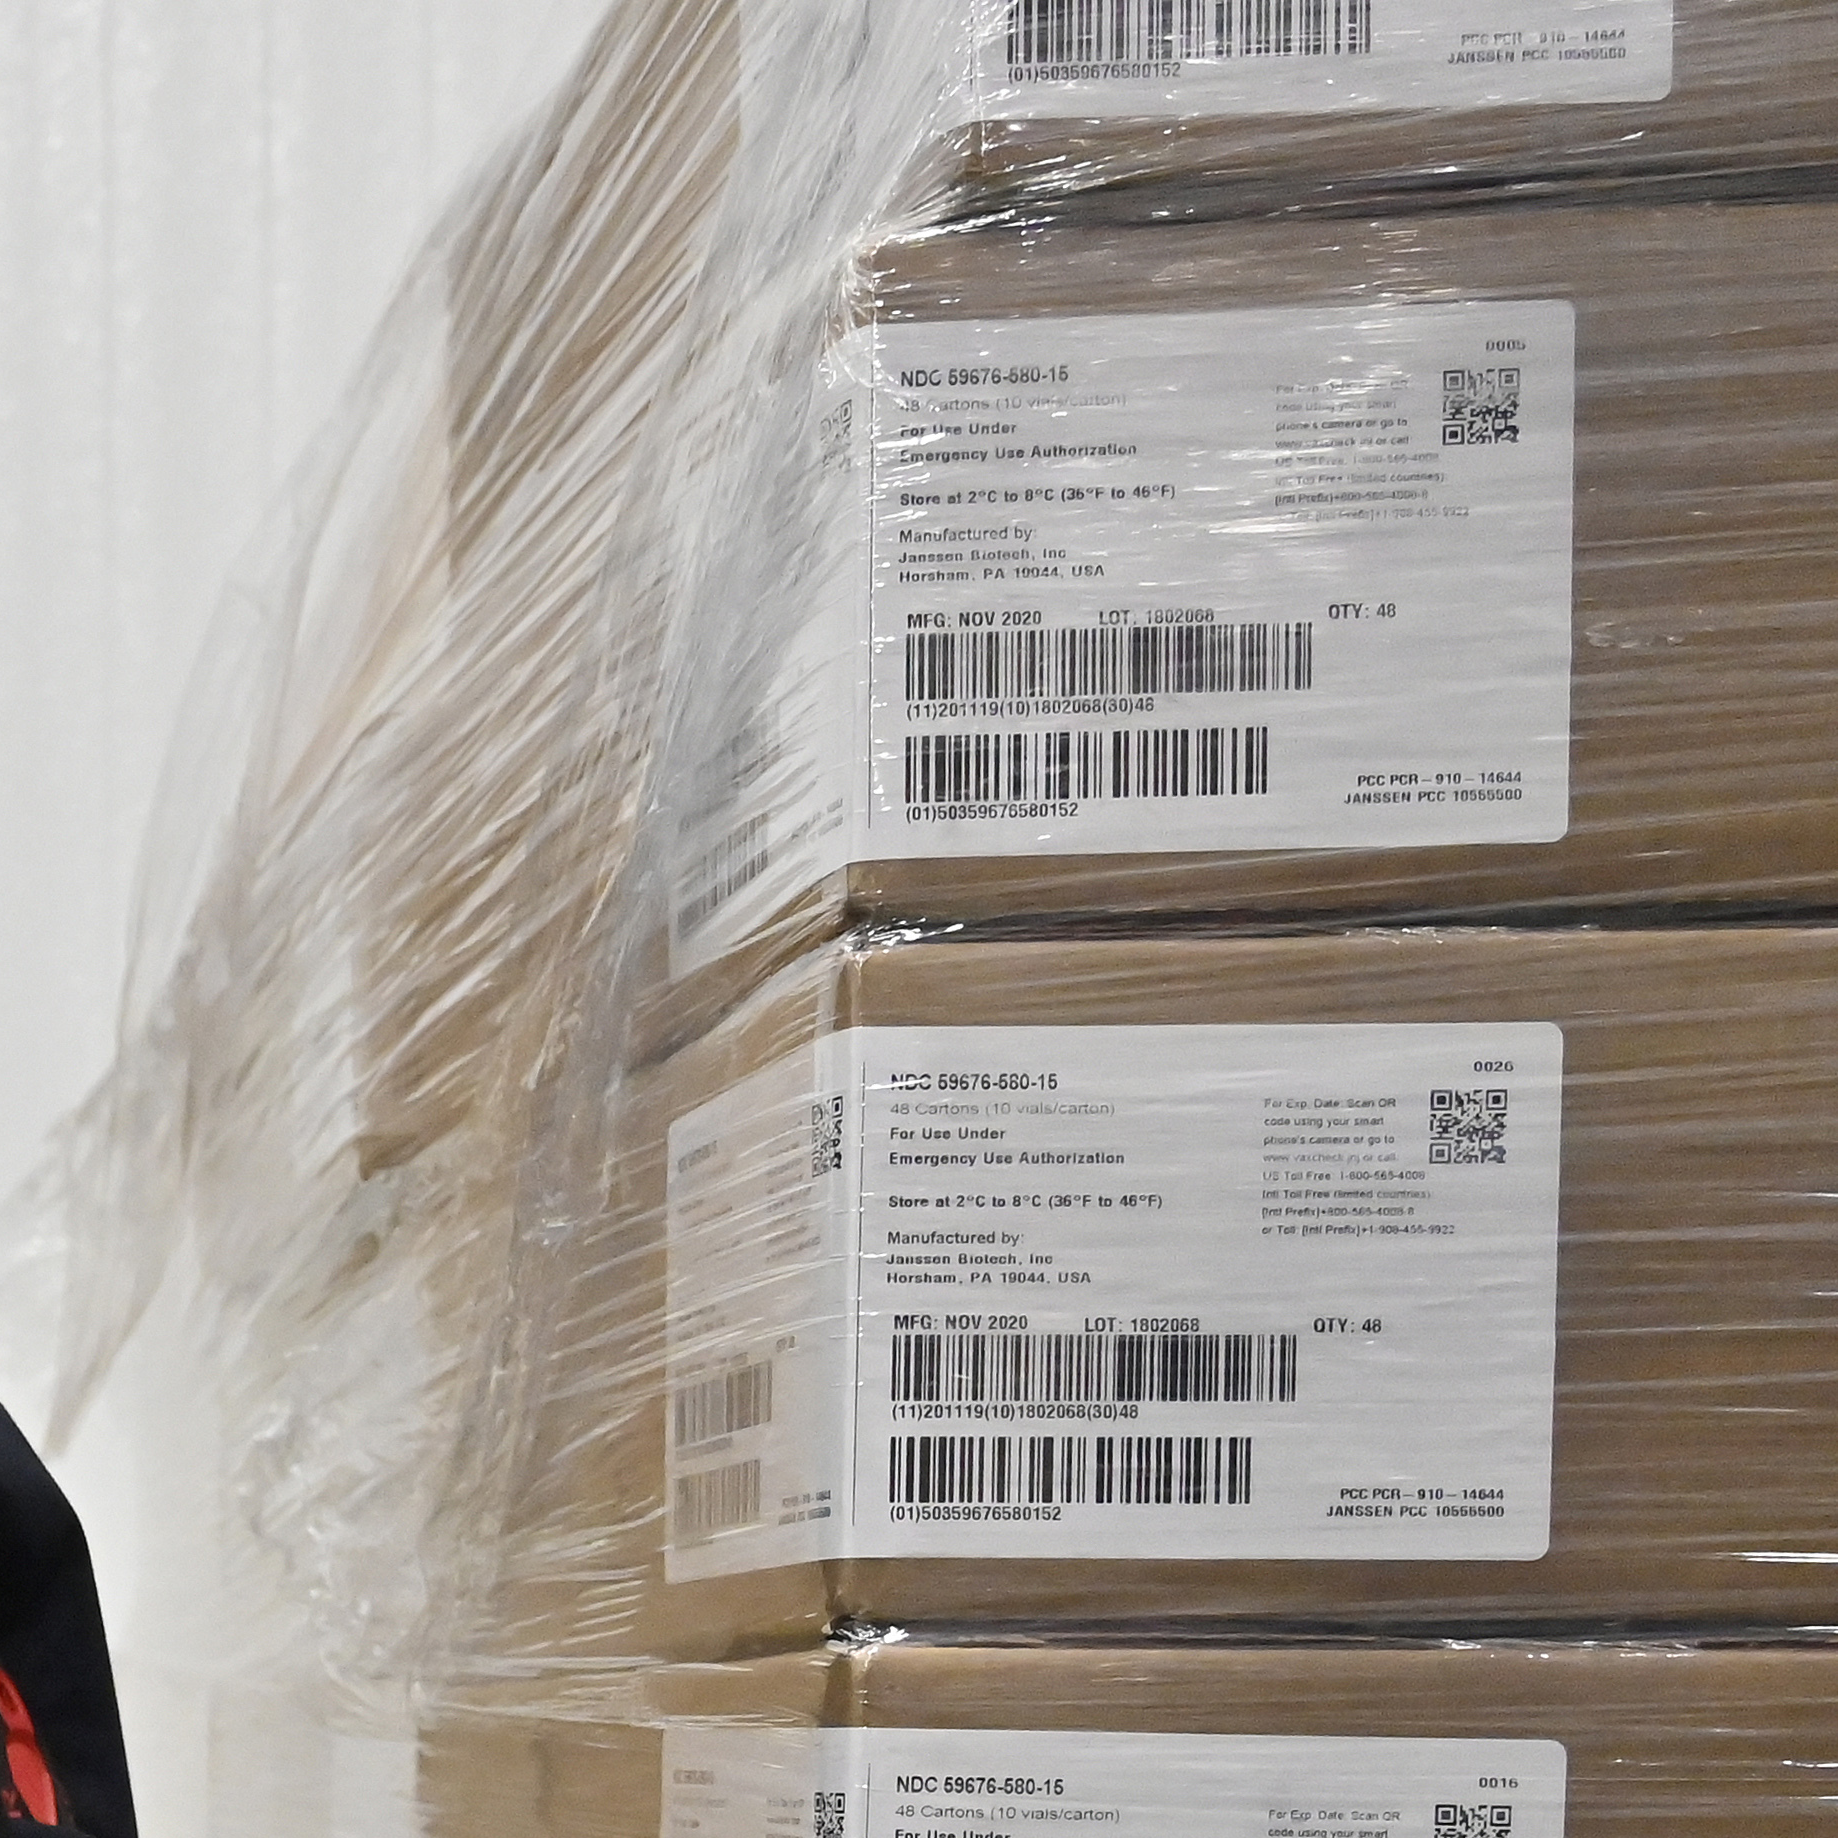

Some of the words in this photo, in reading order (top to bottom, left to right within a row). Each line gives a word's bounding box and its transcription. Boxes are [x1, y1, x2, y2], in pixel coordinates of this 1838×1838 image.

[901, 370, 941, 387] NDC
[948, 366, 1068, 385] 59676-580-15
[906, 802, 1077, 823] (01)50359676580152
[891, 1074, 931, 1090] NDC
[938, 1073, 1057, 1090] 59676-580-15
[890, 1506, 1060, 1523] (01)50359676580152
[897, 1776, 937, 1792] NDC
[944, 1777, 1063, 1795] 59676-580-15
[1479, 1778, 1518, 1787] 0016
[895, 1805, 914, 1817] 48
[921, 1806, 983, 1818] Cartons
